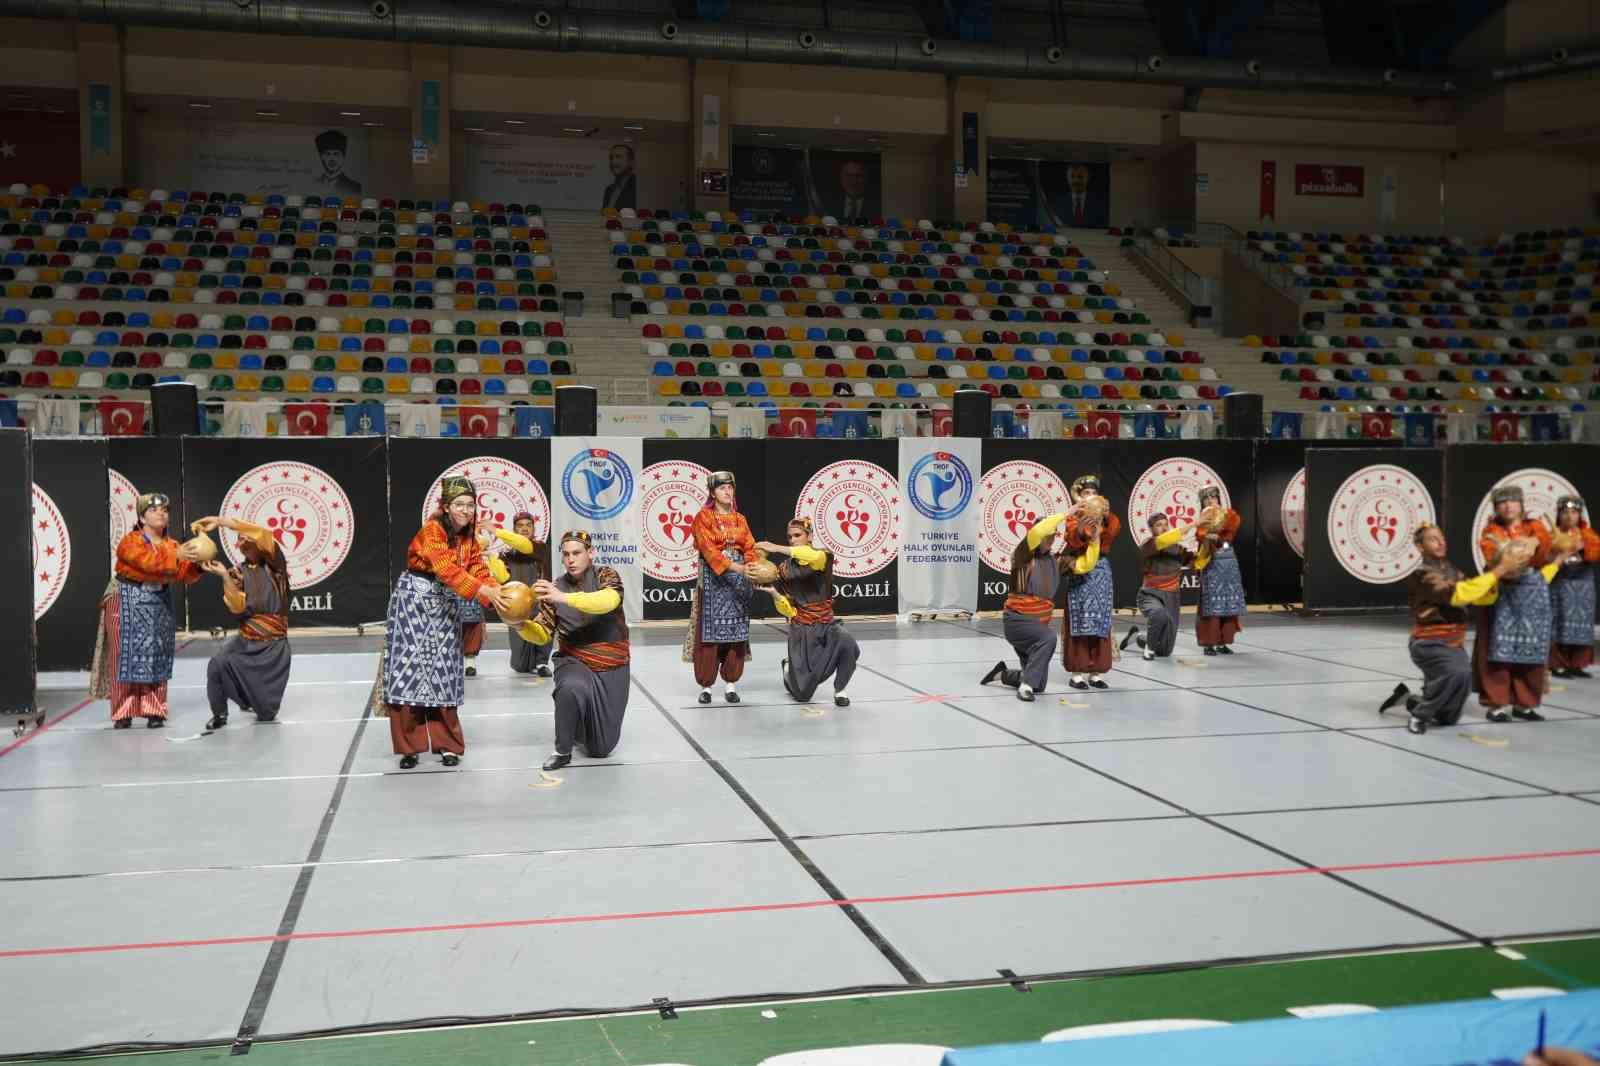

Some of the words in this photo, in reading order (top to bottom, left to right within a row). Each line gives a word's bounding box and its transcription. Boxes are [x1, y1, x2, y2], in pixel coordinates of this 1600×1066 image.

[597, 545, 637, 553] YUNLARI
[904, 544, 929, 552] HALK
[907, 555, 972, 563] FEDERASYONU
[832, 580, 890, 598] OCAELİ
[290, 592, 333, 611] AELİ
